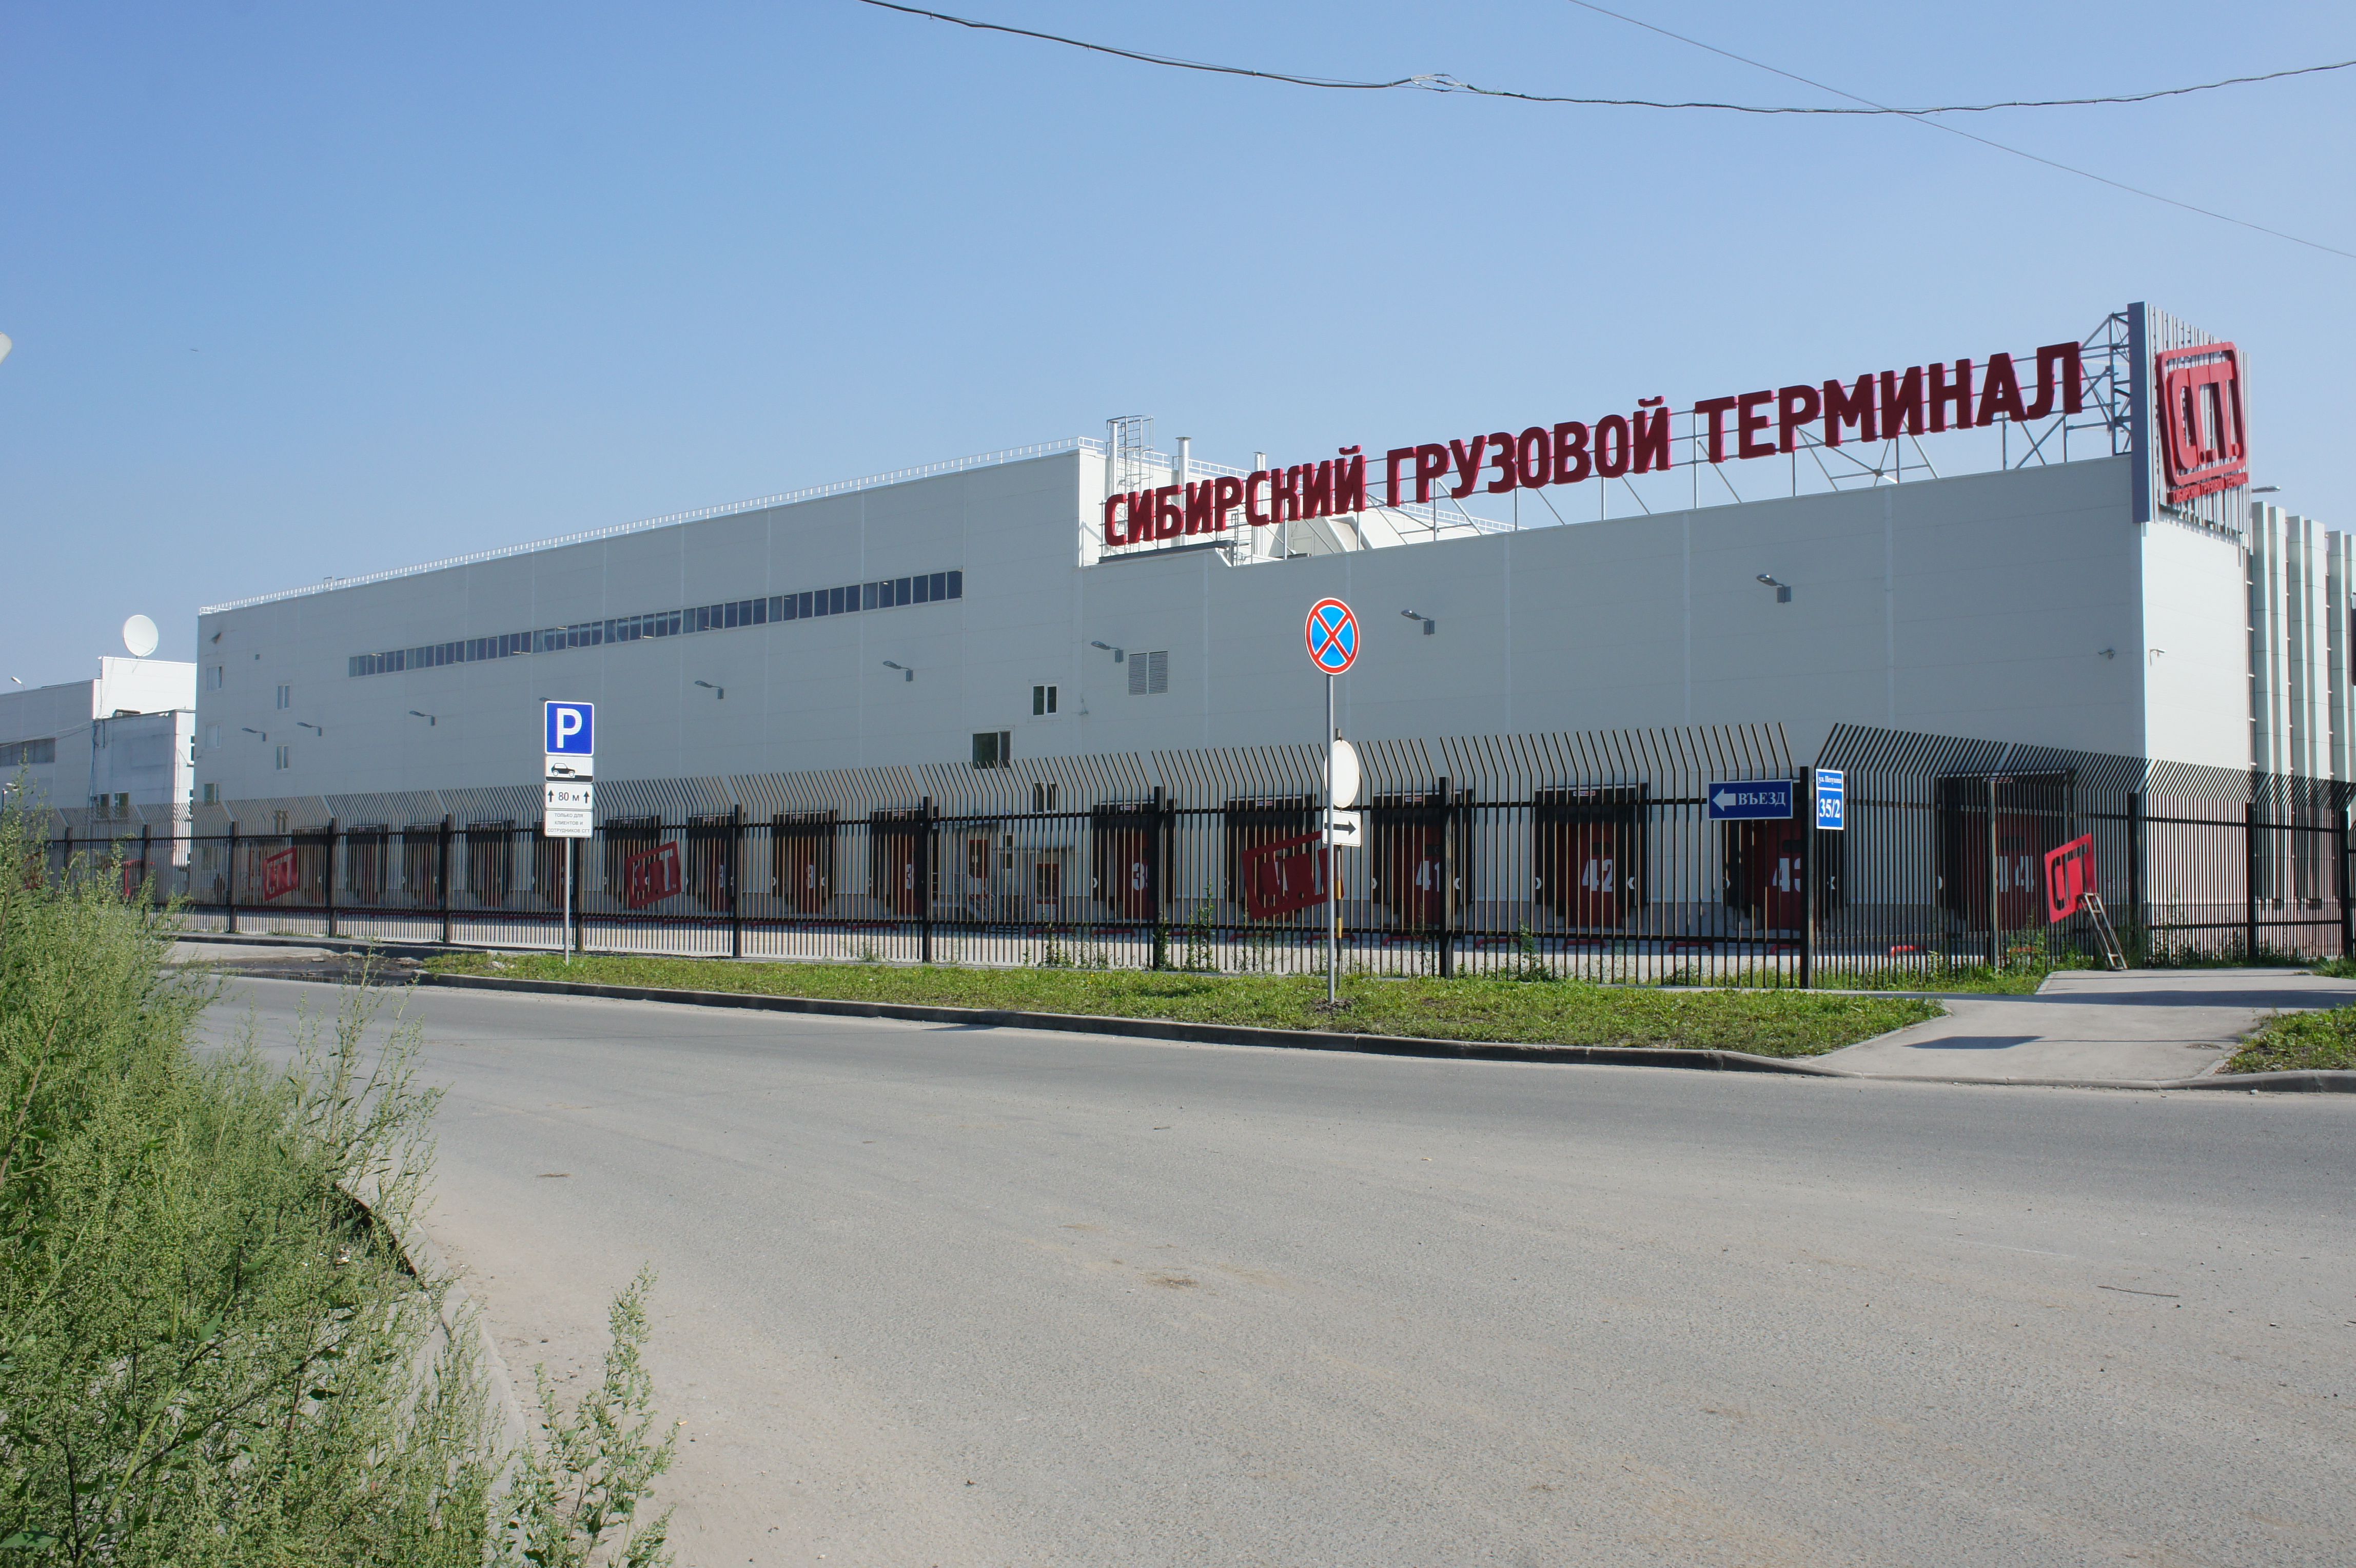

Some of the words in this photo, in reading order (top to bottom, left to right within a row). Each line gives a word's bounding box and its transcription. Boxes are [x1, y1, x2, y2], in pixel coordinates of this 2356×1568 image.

[1104, 445, 1366, 546] СИБИРСКИЙ
[1386, 395, 1671, 507] ГРУЗОВОЙ
[1695, 341, 2082, 463] ТЕРМИНАЛ
[557, 708, 582, 748] P
[558, 792, 569, 801] 80
[1738, 792, 1786, 807] ВЪЕЗД
[1819, 798, 1840, 818] 35/2
[1416, 860, 1440, 892] 41
[1582, 859, 1613, 892] 42
